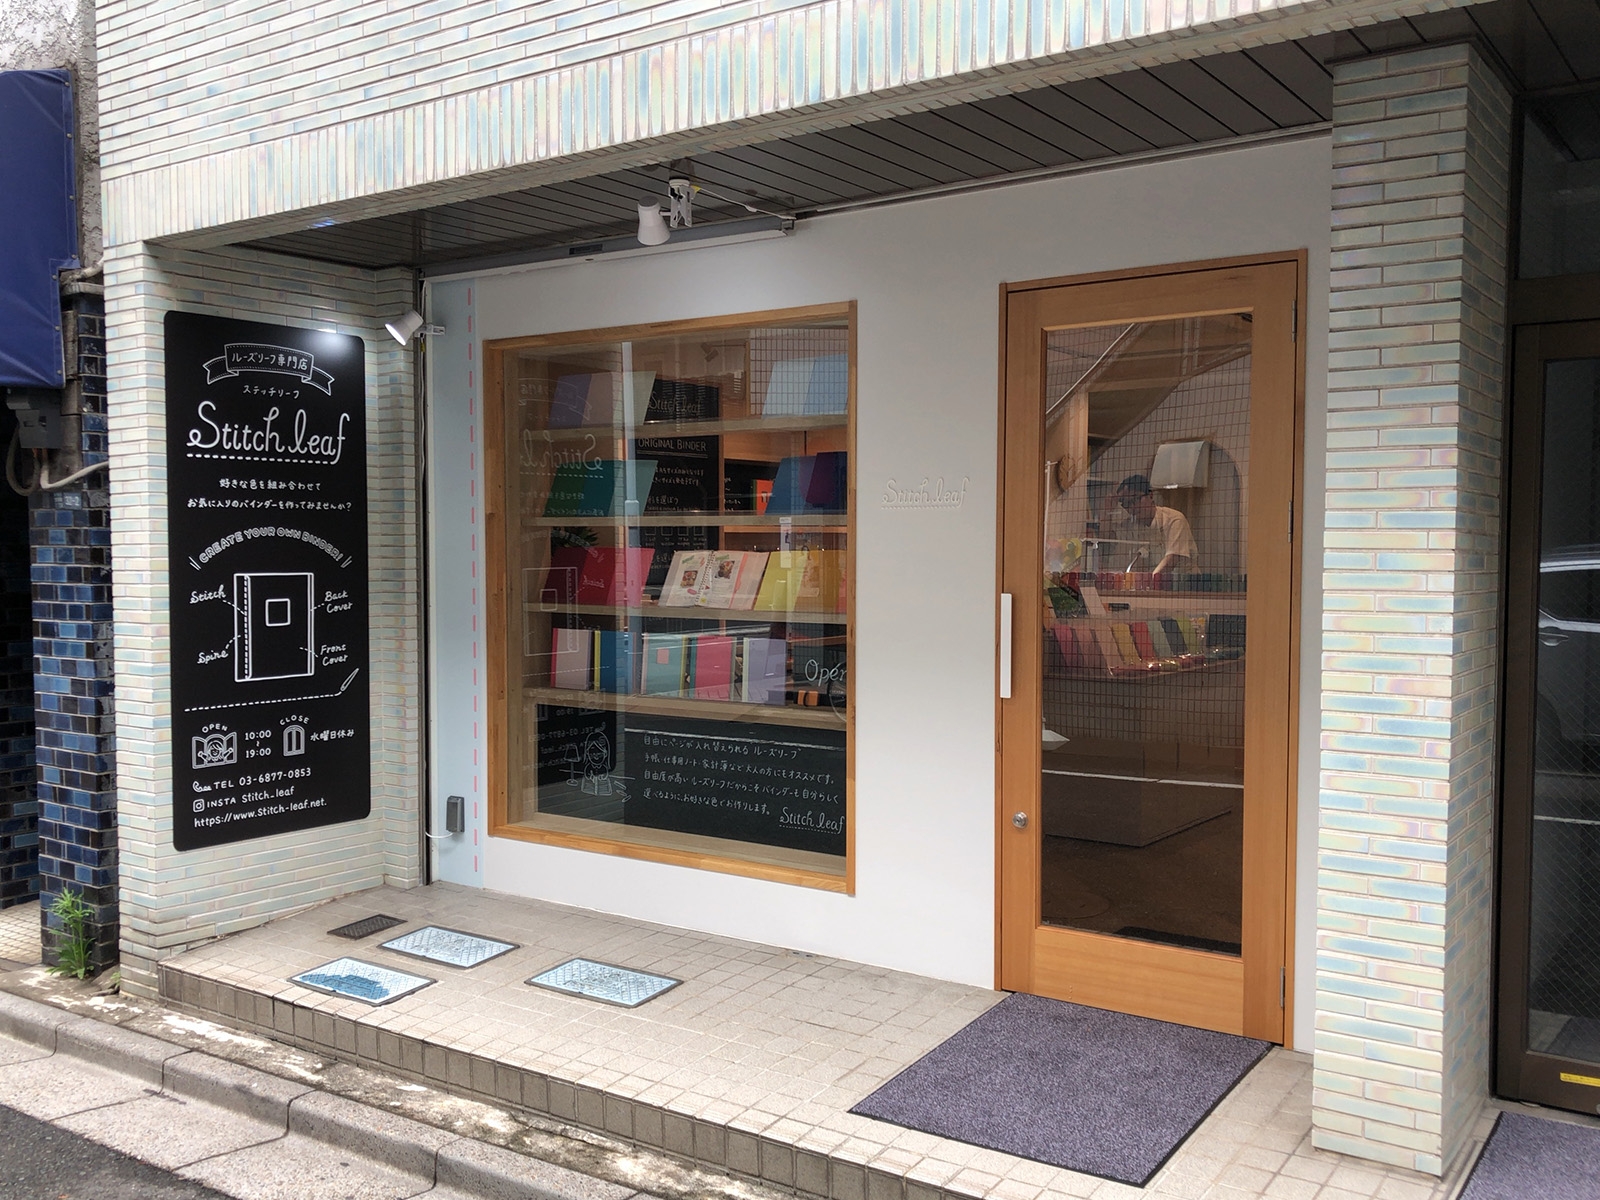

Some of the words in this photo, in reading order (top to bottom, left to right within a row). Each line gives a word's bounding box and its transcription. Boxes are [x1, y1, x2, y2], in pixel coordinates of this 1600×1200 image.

[231, 352, 308, 371] ルーズリーフ専門店
[243, 384, 300, 399] ステッチリーフ
[186, 401, 285, 452] Stitch
[287, 409, 350, 465] leaf
[638, 438, 675, 449] ORIGINAL
[676, 439, 707, 452] BINDER
[218, 478, 321, 491] 好きな色を組み合わせて
[881, 479, 931, 505] Stitch
[931, 476, 970, 508] leaf
[199, 531, 244, 564] CREATE
[243, 526, 276, 540] YOUR
[276, 527, 302, 540] OWN
[300, 531, 344, 562] BINDER!
[190, 584, 227, 604] Stitch
[324, 591, 349, 602] Back
[326, 602, 353, 614] Cover
[320, 644, 347, 655] Front
[197, 650, 229, 664] Spine
[322, 654, 348, 666] Cover
[279, 714, 310, 726] CLOSE
[201, 723, 228, 733] OPEN
[244, 729, 272, 741] 10:00
[309, 729, 356, 742] 水曜日休み
[245, 748, 272, 758] 19:00
[213, 779, 234, 790] TEL
[238, 767, 312, 786] 03-6877-0853
[207, 796, 237, 808] INSTA
[779, 806, 815, 827] Stitch
[815, 812, 845, 835] leaf
